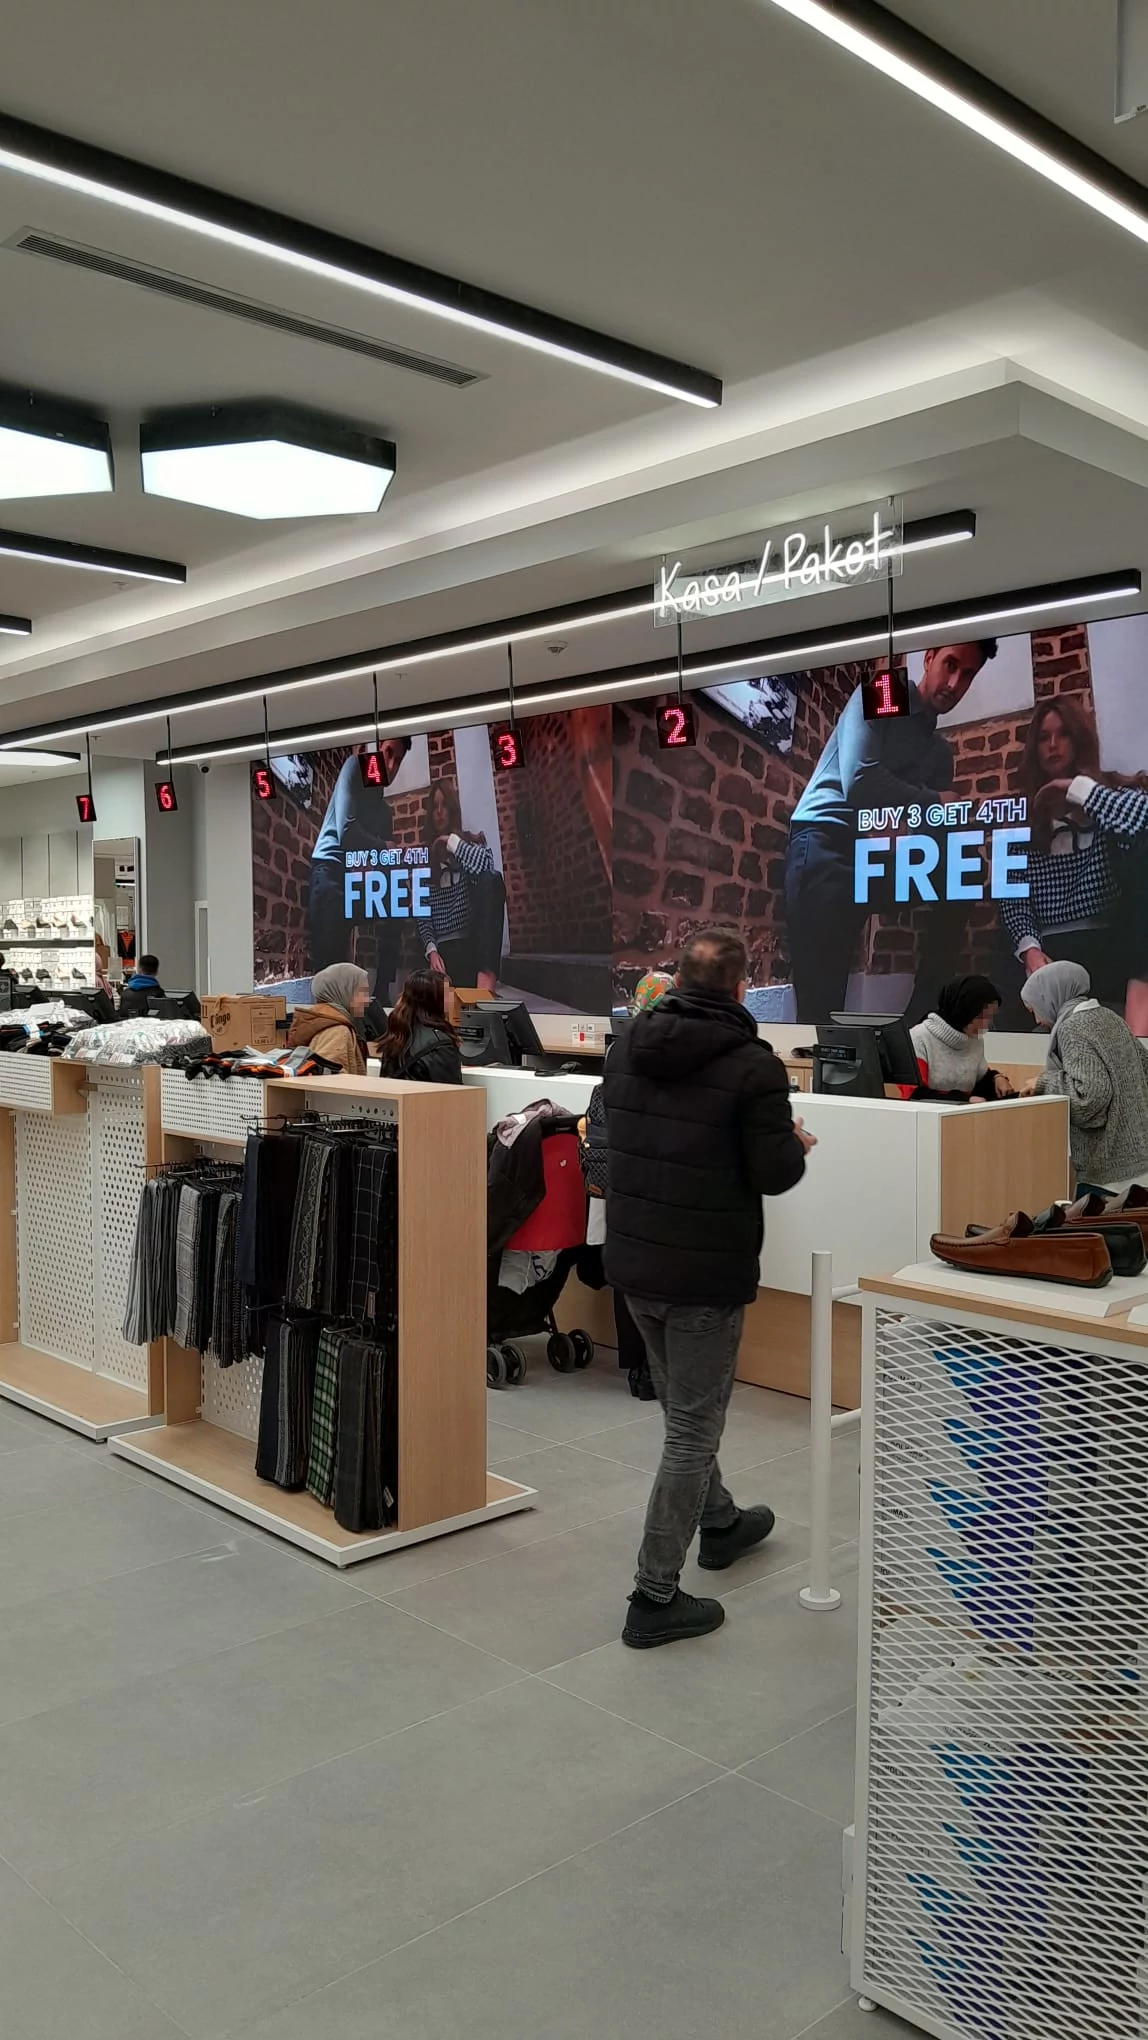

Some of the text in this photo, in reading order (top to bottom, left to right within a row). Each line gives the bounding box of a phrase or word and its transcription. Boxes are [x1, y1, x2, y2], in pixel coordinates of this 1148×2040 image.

[659, 561, 742, 618] Kasa
[784, 511, 894, 590] Paket
[875, 674, 899, 714] 1
[664, 708, 687, 744] 2
[498, 734, 517, 767] 3
[255, 771, 270, 798] 5
[367, 755, 381, 783] 4
[79, 797, 89, 820] 7
[159, 785, 172, 810] 6
[857, 797, 1027, 832] BUY 3 GET 4TH
[345, 847, 429, 868] BUY 3 GET 4TH
[854, 827, 1032, 904] FREE
[344, 867, 432, 919] FREE
